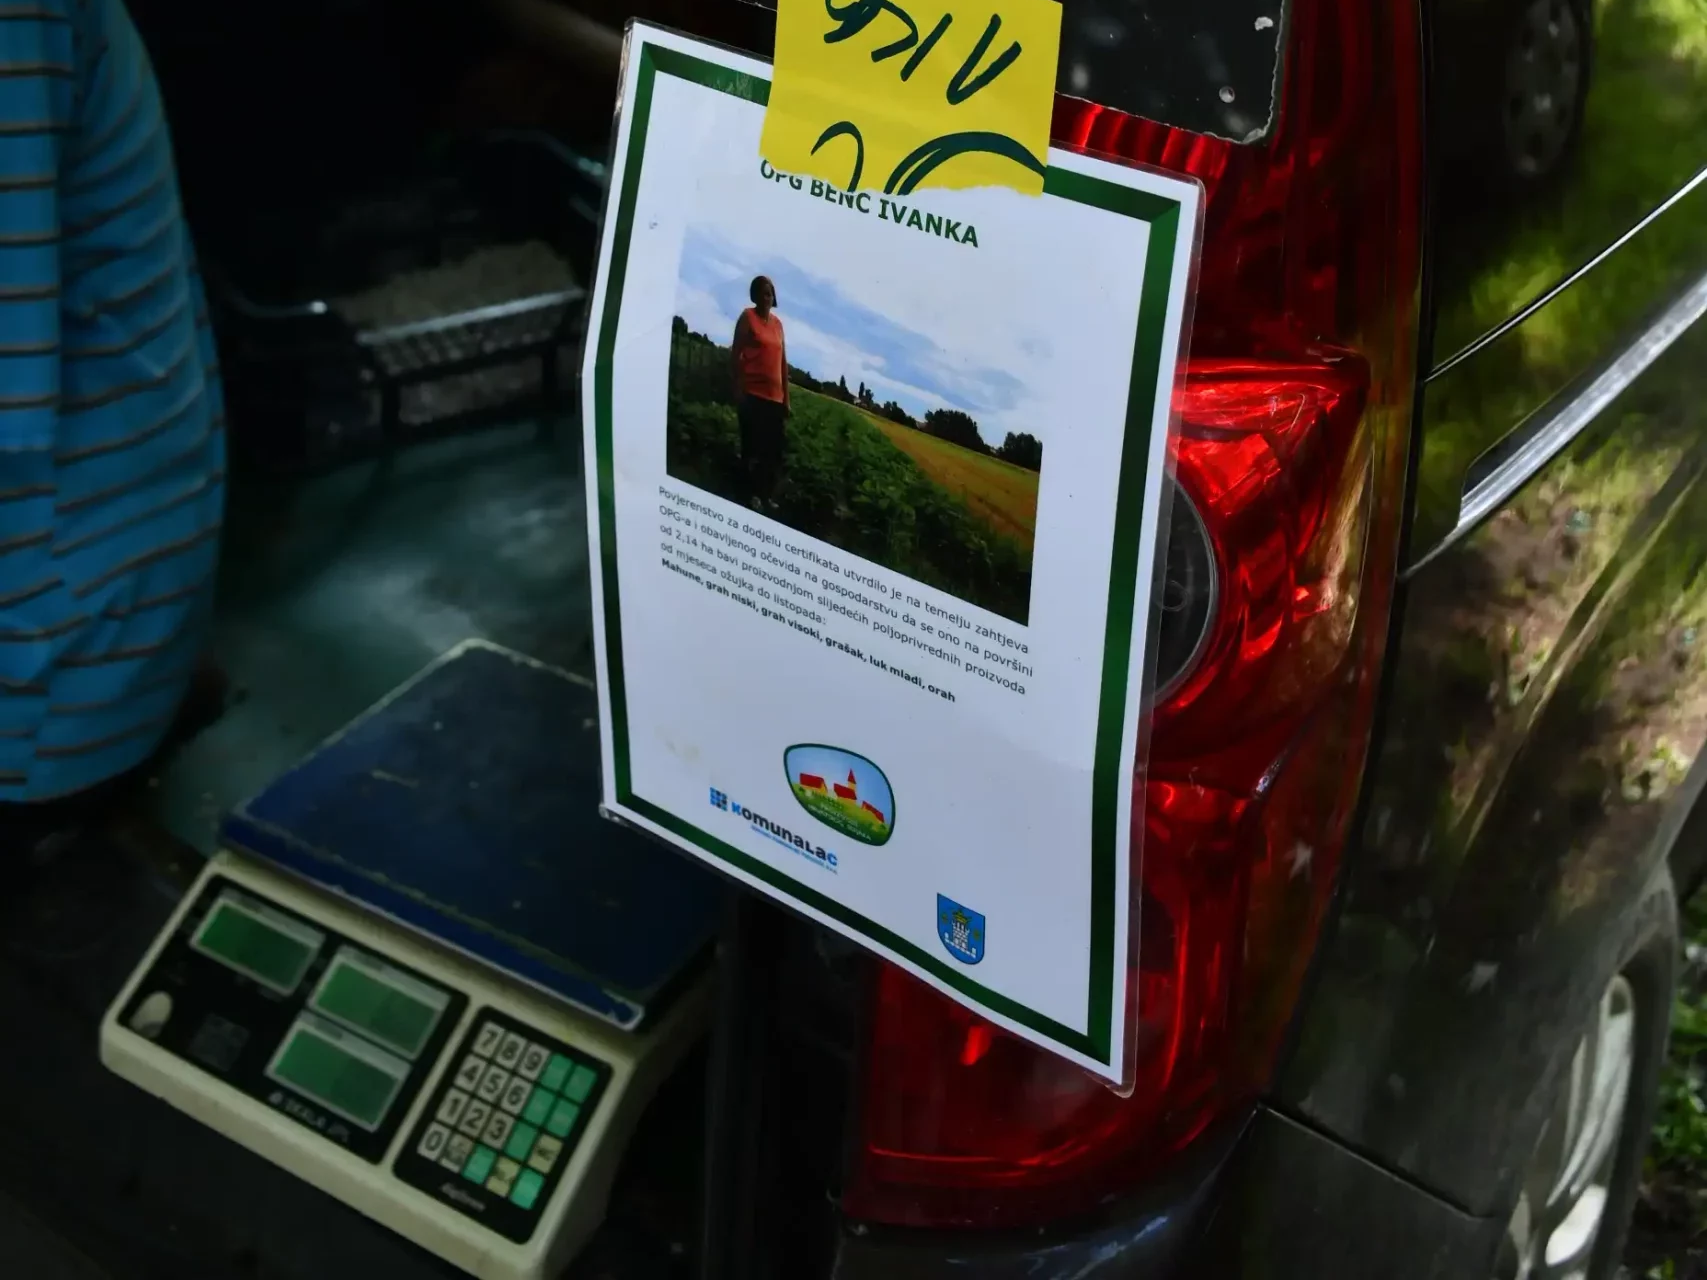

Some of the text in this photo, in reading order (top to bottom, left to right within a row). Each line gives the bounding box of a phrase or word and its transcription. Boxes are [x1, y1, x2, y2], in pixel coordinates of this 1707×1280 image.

[810, 178, 871, 214] BENC
[878, 198, 979, 248] IVANKA
[659, 486, 1029, 654] Povjerenstvo za dodjelu certifikata utvrdilo je na temelju zahtjeva
[659, 505, 691, 526] OPG-a
[701, 524, 757, 558] obavljenog
[760, 551, 801, 575] očevida
[804, 571, 818, 583] na
[821, 579, 898, 618] gospodarstvu
[902, 613, 916, 627] da
[920, 622, 934, 634] se
[937, 630, 960, 646] ono
[964, 641, 979, 654] na
[984, 649, 1033, 677] površini
[660, 542, 827, 625] od mjeseca ožujka do listopada:
[660, 524, 672, 536] od
[701, 541, 714, 555] ha
[717, 549, 739, 566] bavi
[741, 562, 814, 601] proizvodnjom
[817, 595, 869, 625] slijedećih
[873, 621, 961, 667] poljoprivrednih
[965, 662, 1026, 695] proizvoda
[661, 558, 956, 703] Mahune, grah niski, grah visoki, grašak, luk mladi, orah
[463, 1064, 525, 1106] 4 5 6
[480, 1029, 542, 1071] 7 8 9
[425, 1130, 443, 1152] 0
[467, 1108, 484, 1130] 2
[487, 1120, 506, 1140] 3
